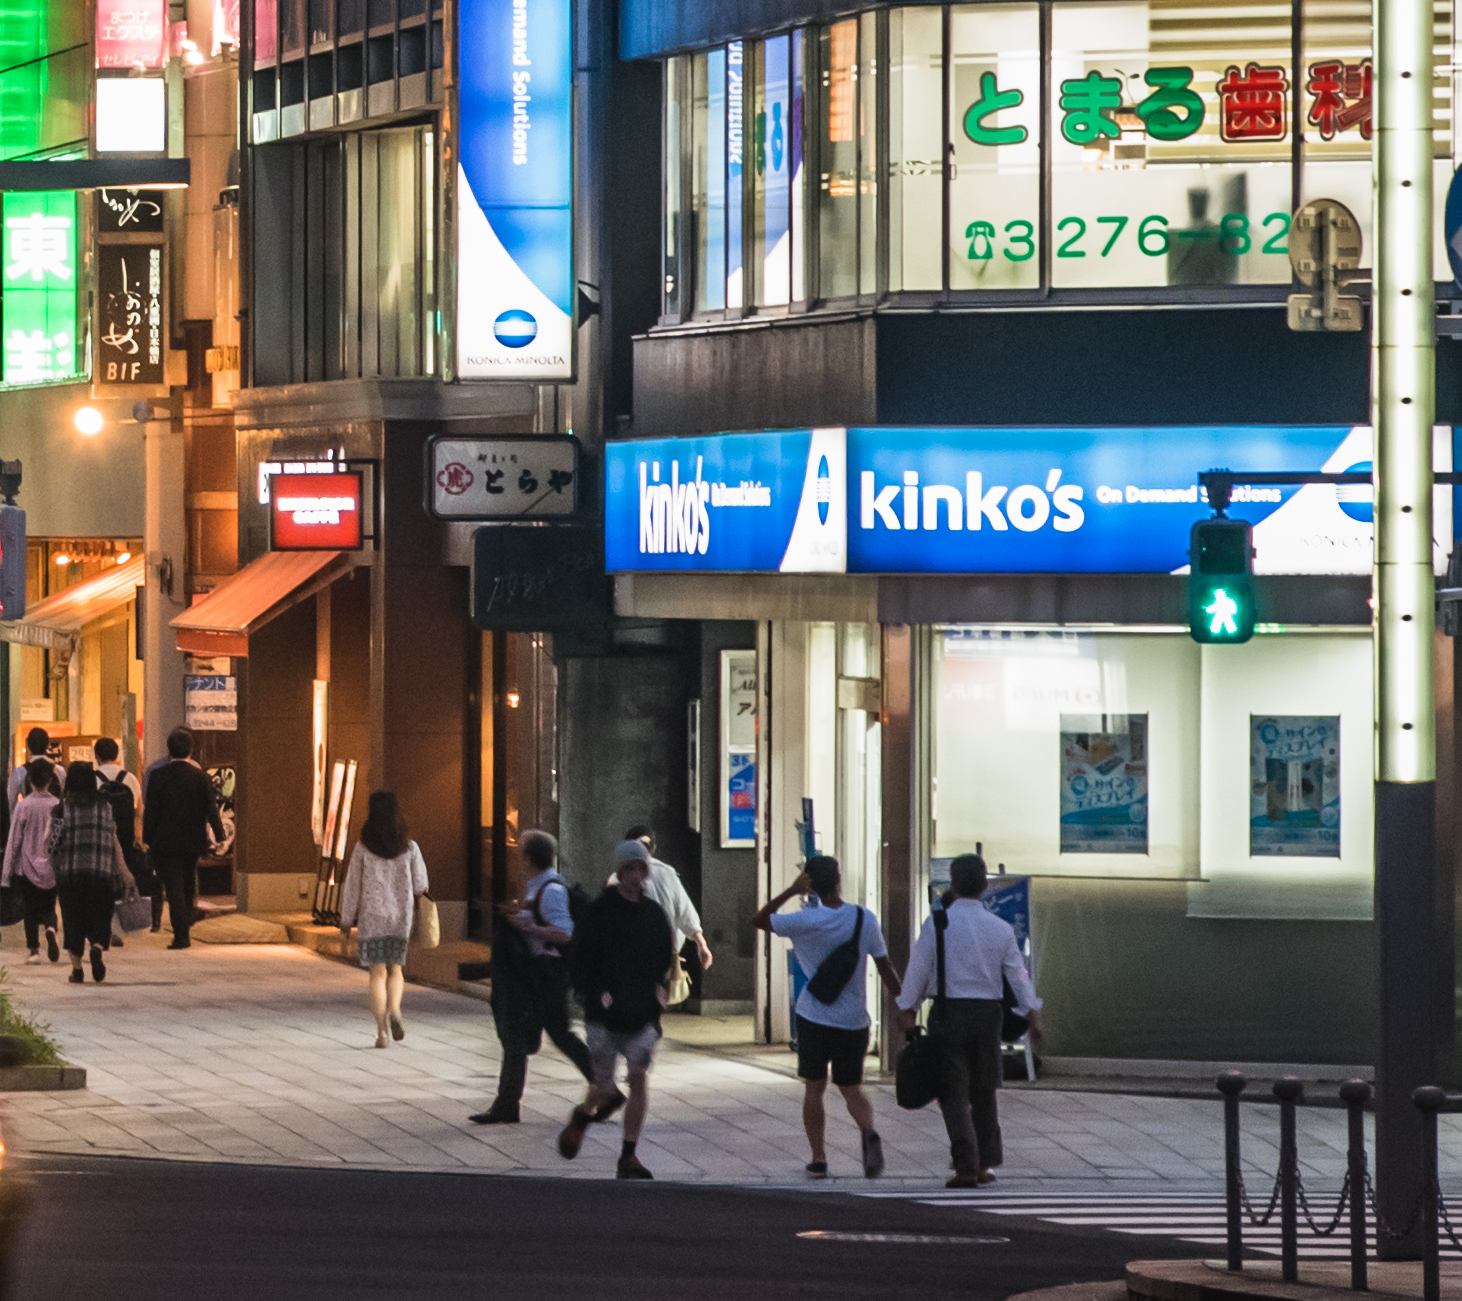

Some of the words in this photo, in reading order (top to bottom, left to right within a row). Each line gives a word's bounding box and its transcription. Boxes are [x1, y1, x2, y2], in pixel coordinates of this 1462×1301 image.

[107, 7, 152, 26] まつげ
[101, 26, 160, 42] エクステ
[512, 60, 531, 166] Solutions
[467, 355, 513, 366] KONICA
[516, 355, 565, 366] MINOLTA
[485, 469, 573, 494] とらや
[639, 455, 710, 555] kinko's
[860, 469, 1085, 533] kinko's
[1096, 485, 1122, 504] On
[1127, 483, 1196, 504] Demand
